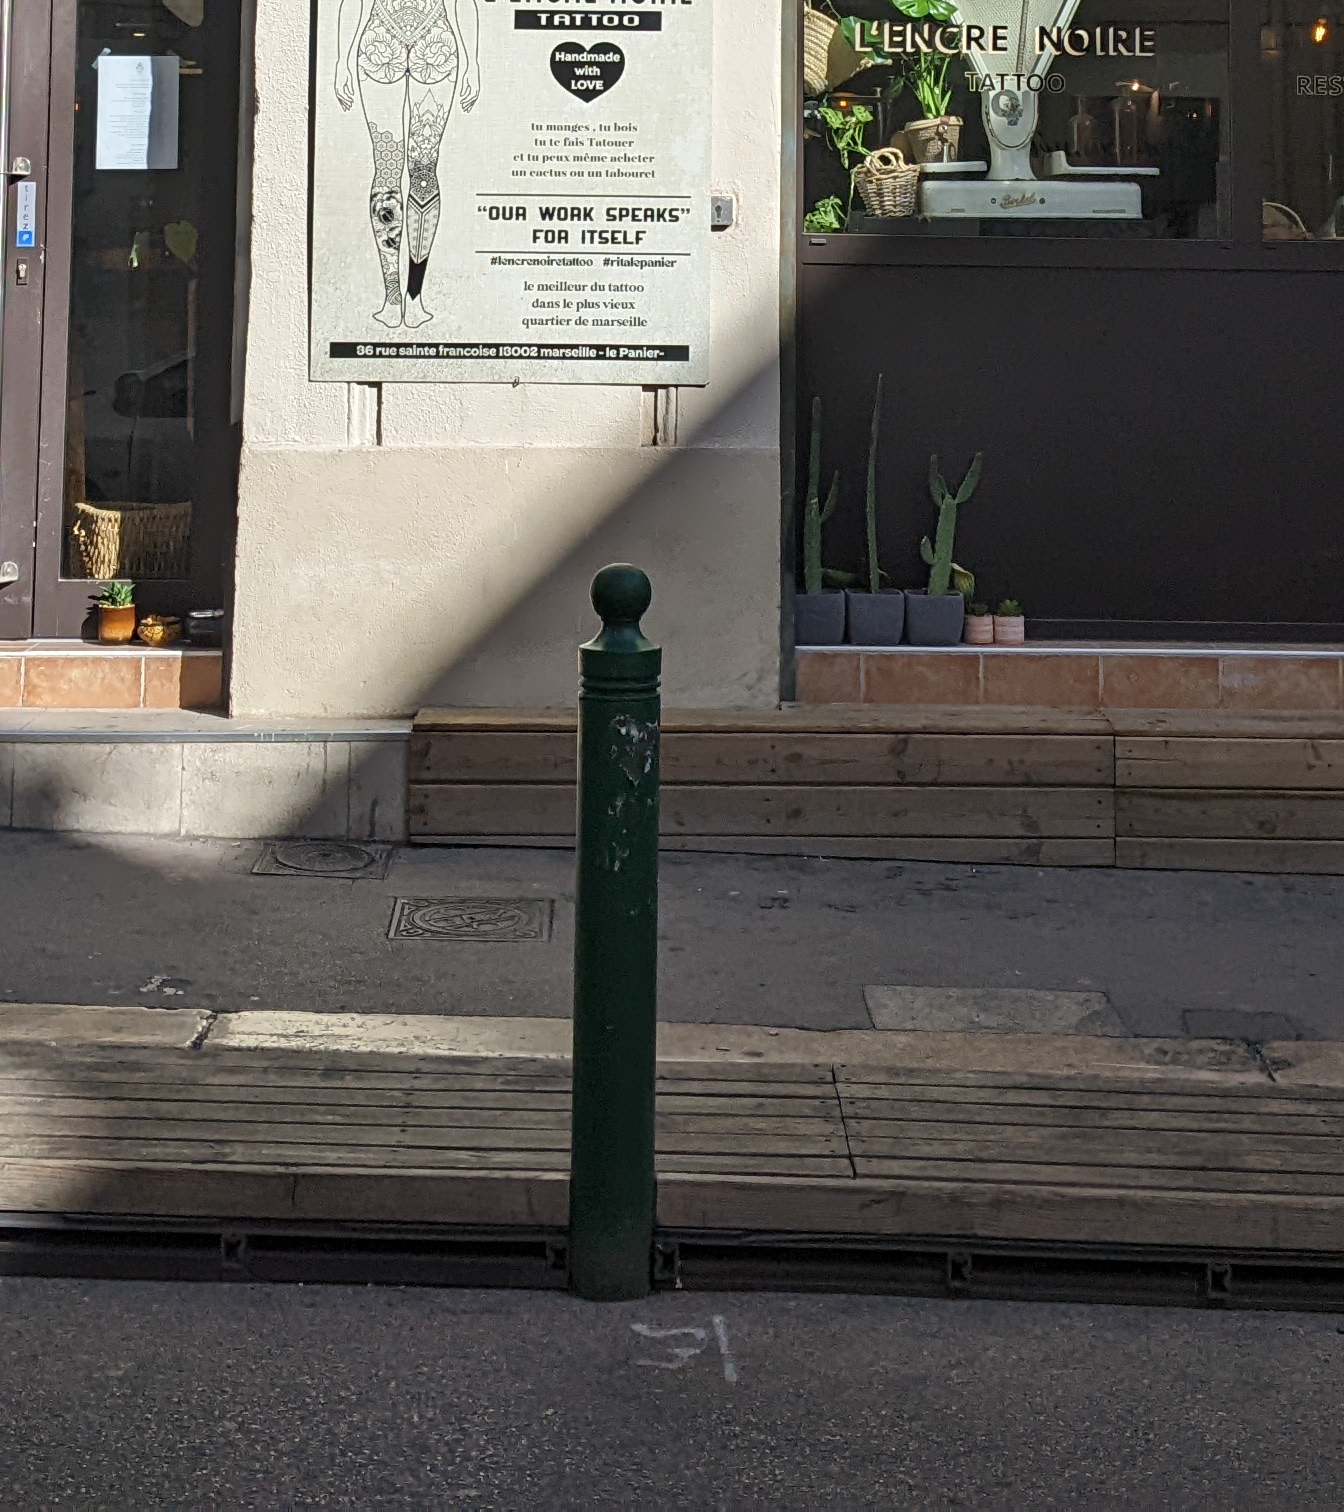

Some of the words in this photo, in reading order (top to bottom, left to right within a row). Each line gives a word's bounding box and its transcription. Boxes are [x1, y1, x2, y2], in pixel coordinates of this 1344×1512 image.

[536, 13, 640, 27] TATTOO
[854, 21, 1009, 55] L'ENCRE
[1035, 26, 1156, 57] NOIRE
[554, 51, 621, 63] Handmade
[574, 65, 601, 76] with
[571, 79, 604, 90] LOVE
[964, 71, 1066, 95] TATTOO
[531, 122, 543, 132] tu
[546, 122, 590, 134] manges
[599, 122, 611, 132] tu
[614, 122, 638, 132] bois
[534, 137, 546, 147] tu
[549, 137, 560, 147] te
[563, 137, 585, 147] fais
[587, 137, 635, 148] Tatouer
[513, 153, 524, 162] et
[527, 153, 539, 162] tu
[542, 154, 570, 164] peux
[572, 152, 607, 163] même
[610, 153, 655, 163] acheter
[511, 169, 527, 178] un
[529, 168, 567, 178] cactus
[569, 170, 585, 178] ou
[587, 170, 602, 178] un
[605, 168, 656, 178] tabouret
[538, 206, 595, 222] WORK
[532, 229, 569, 244] FOR
[581, 230, 647, 245] ITSELF
[490, 255, 594, 267] #lencrenoiretattoo
[602, 256, 677, 269] #ritalepanier
[523, 281, 534, 292] le
[536, 281, 588, 292] meilleur
[590, 281, 605, 292] du
[608, 282, 644, 293] tattoo
[531, 298, 560, 309] dans
[562, 298, 573, 309] le
[575, 299, 601, 312] plus
[602, 299, 636, 310] vieux
[521, 316, 572, 329] quartier
[574, 316, 590, 327] de
[591, 316, 648, 328] marseille
[375, 346, 398, 356] rue
[398, 345, 437, 356] sainte
[438, 345, 496, 357] francoise
[498, 346, 538, 357] 13002
[540, 346, 597, 358] marseille
[606, 347, 617, 358] le
